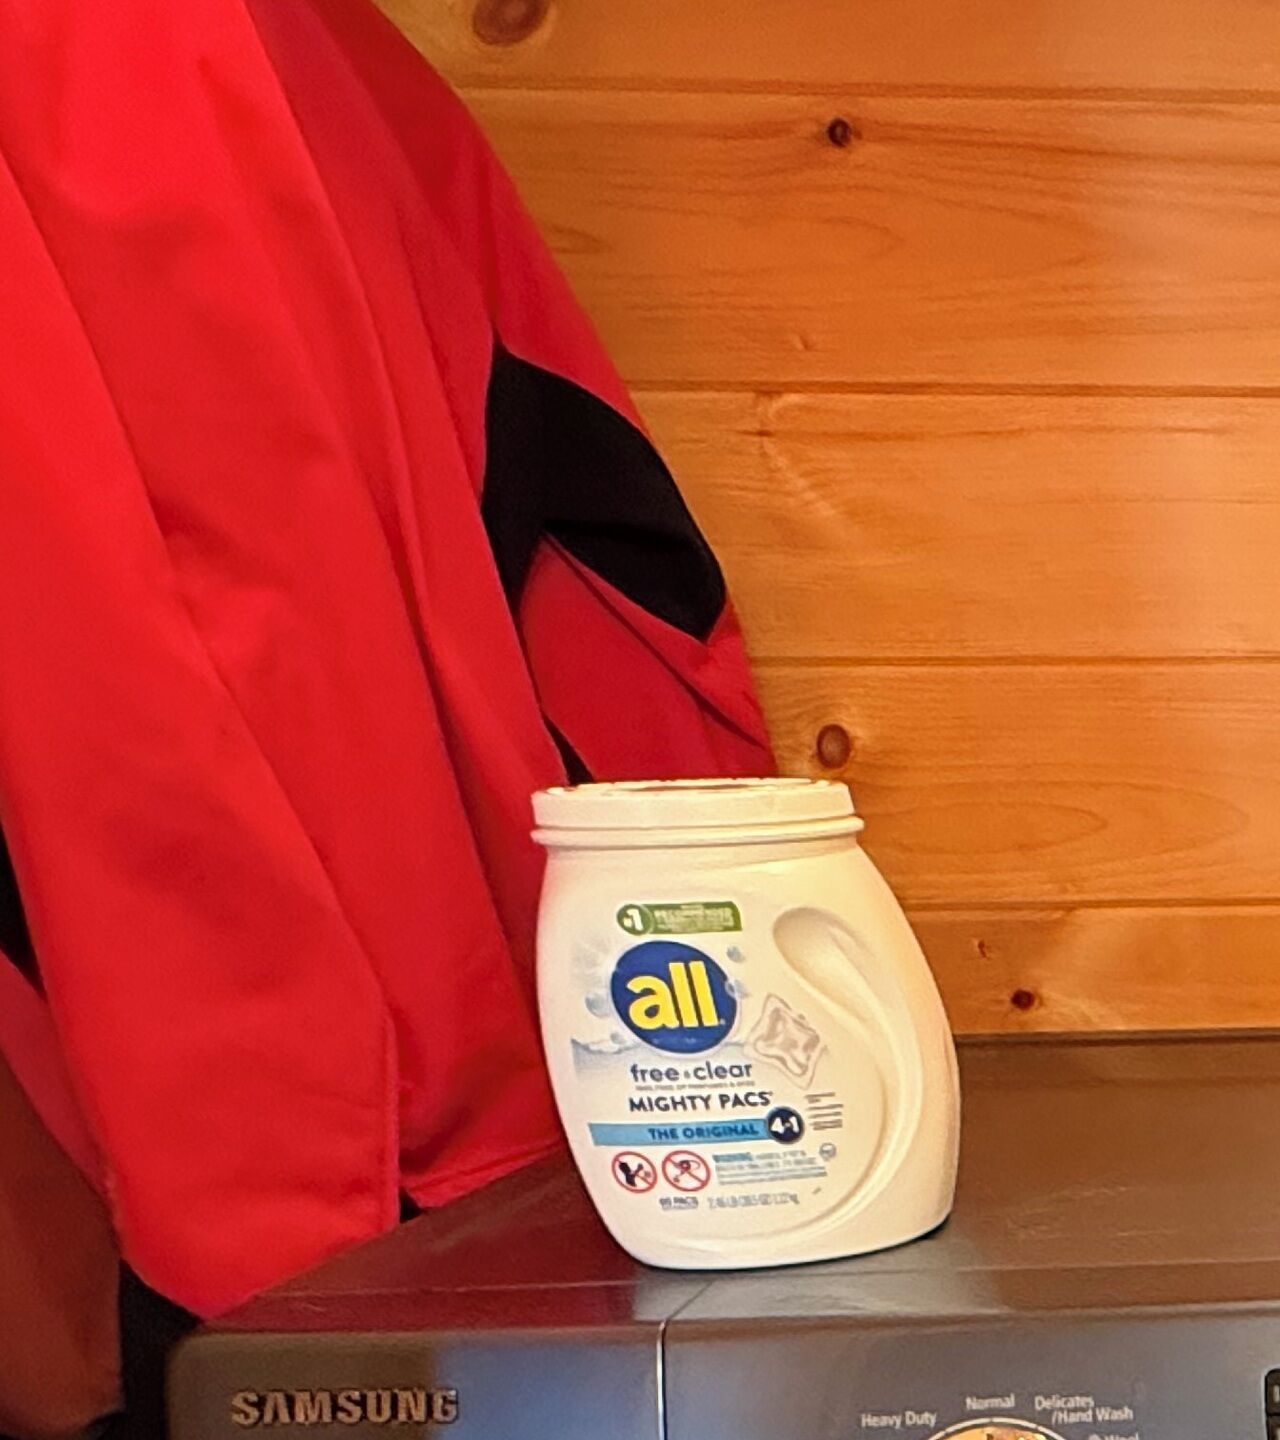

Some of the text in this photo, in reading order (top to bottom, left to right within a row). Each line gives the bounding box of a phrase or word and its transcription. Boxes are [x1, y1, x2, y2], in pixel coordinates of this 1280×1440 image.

[626, 960, 719, 1030] all
[630, 1063, 680, 1082] free
[693, 1060, 753, 1080] clear
[629, 1094, 712, 1112] MIGHTY
[649, 1122, 760, 1141] THE ORIGINAL
[231, 1388, 460, 1426] SAMSUNG
[966, 1394, 1015, 1411] Normal
[1034, 1394, 1095, 1411] Delicates
[861, 1411, 937, 1430] Heavy Duty
[1095, 1406, 1134, 1422] Wash
